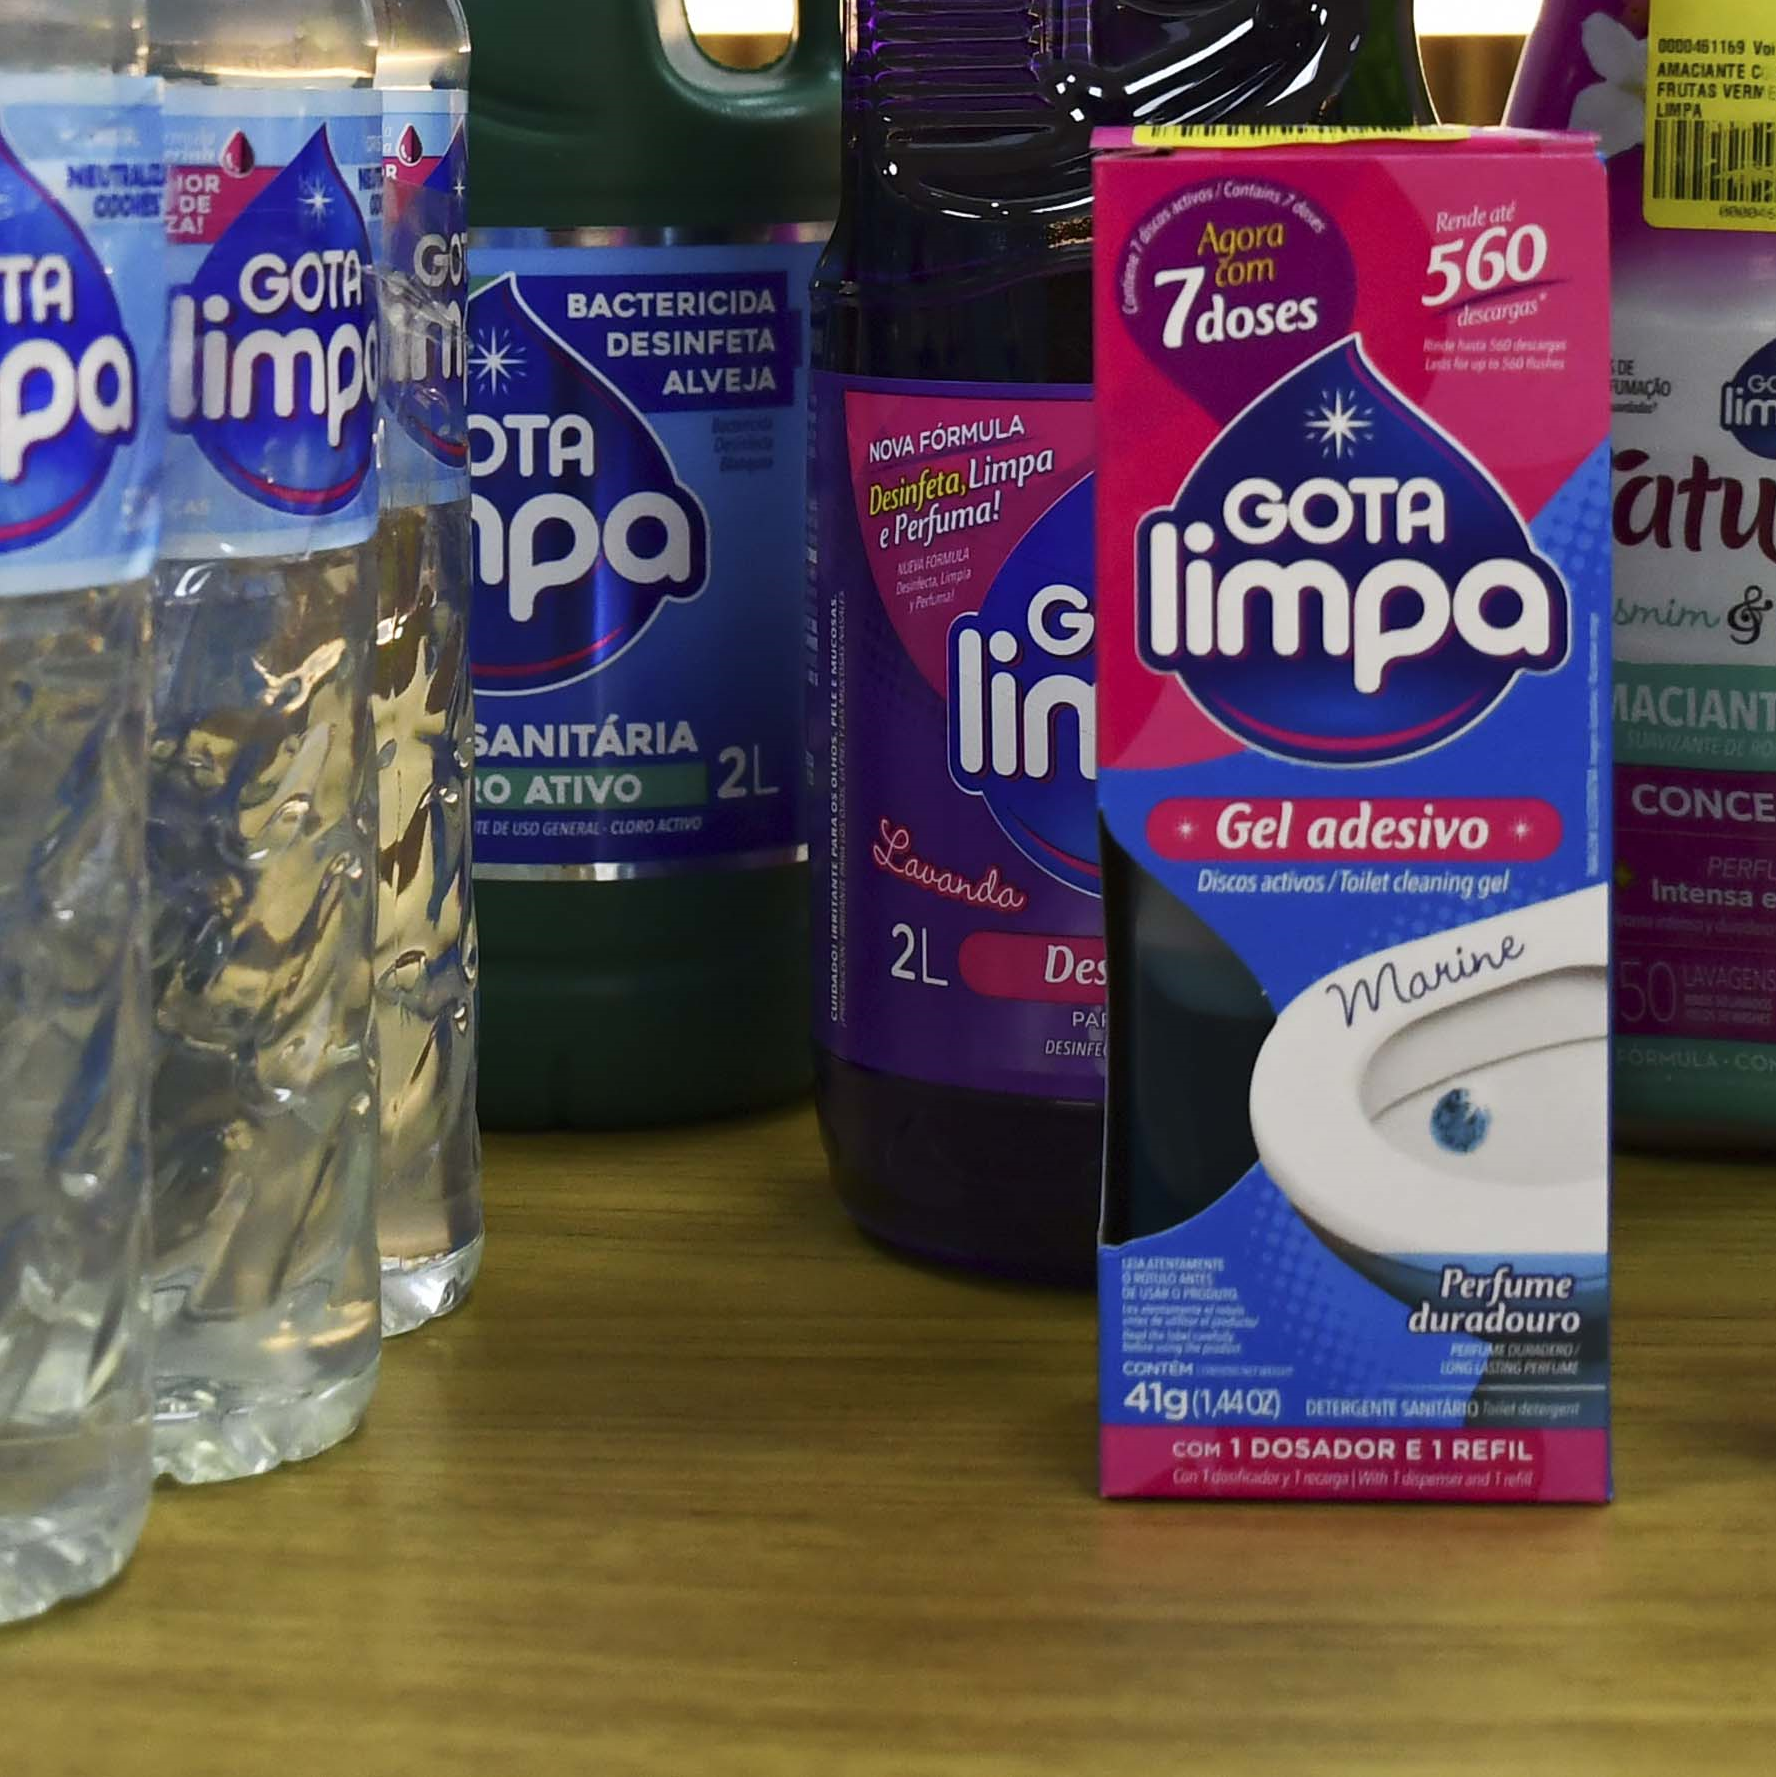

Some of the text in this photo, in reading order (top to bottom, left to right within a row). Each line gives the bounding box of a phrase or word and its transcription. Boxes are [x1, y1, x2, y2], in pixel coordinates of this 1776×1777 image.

[1657, 63, 1745, 80] AMACIANTE
[1657, 82, 1717, 99] FRUTAS
[1656, 103, 1703, 118] LIMPA
[1171, 185, 1213, 216] activos
[1223, 180, 1279, 205] Contains
[1437, 199, 1517, 234] Rende até
[1198, 221, 1284, 257] Agora
[239, 250, 361, 314] GOTA
[1215, 256, 1275, 288] com
[1422, 224, 1547, 307] 560
[568, 292, 775, 318] BACTERICIDA
[1154, 266, 1318, 349] 7 doses
[607, 330, 775, 357] DESINFETA
[663, 370, 775, 395] ALVEJA
[469, 414, 593, 478] OTA
[869, 414, 1025, 463] NOVA FÓRMULA
[869, 449, 1054, 516] Desinfeta, Limpa
[880, 489, 1001, 549] e Perfuma!
[1223, 478, 1445, 544] GOTA
[1150, 521, 1550, 694] limpa
[1613, 584, 1772, 644] smim &
[830, 594, 840, 674] MUCOSAS.
[830, 691, 840, 727] PELE
[959, 628, 1096, 779] lim
[474, 714, 699, 757] SANITÁRIA
[524, 773, 643, 805] ATIVO
[717, 744, 779, 800] 2L
[830, 792, 840, 812] OS
[830, 816, 840, 857] PARA
[1216, 800, 1489, 850] Gel adesivo
[873, 818, 1025, 910] Lavanda
[1197, 869, 1510, 899] Discos activos Toilet cleaning gel
[830, 861, 840, 939] IRRITANTE
[1652, 878, 1752, 908] Intensa
[890, 923, 948, 987] 2L
[830, 944, 840, 1022] CUIDADO!
[1326, 934, 1524, 1027] Marine
[1440, 1264, 1573, 1306] Perfume
[1408, 1303, 1580, 1335] duradouro
[1123, 1360, 1193, 1377] CONTÉM
[1124, 1380, 1187, 1420] 41g
[1306, 1397, 1479, 1417] DETERGENTE SANITÁRIO
[1173, 1437, 1533, 1461] COM 1 DOSADOR E 1 REFIL
